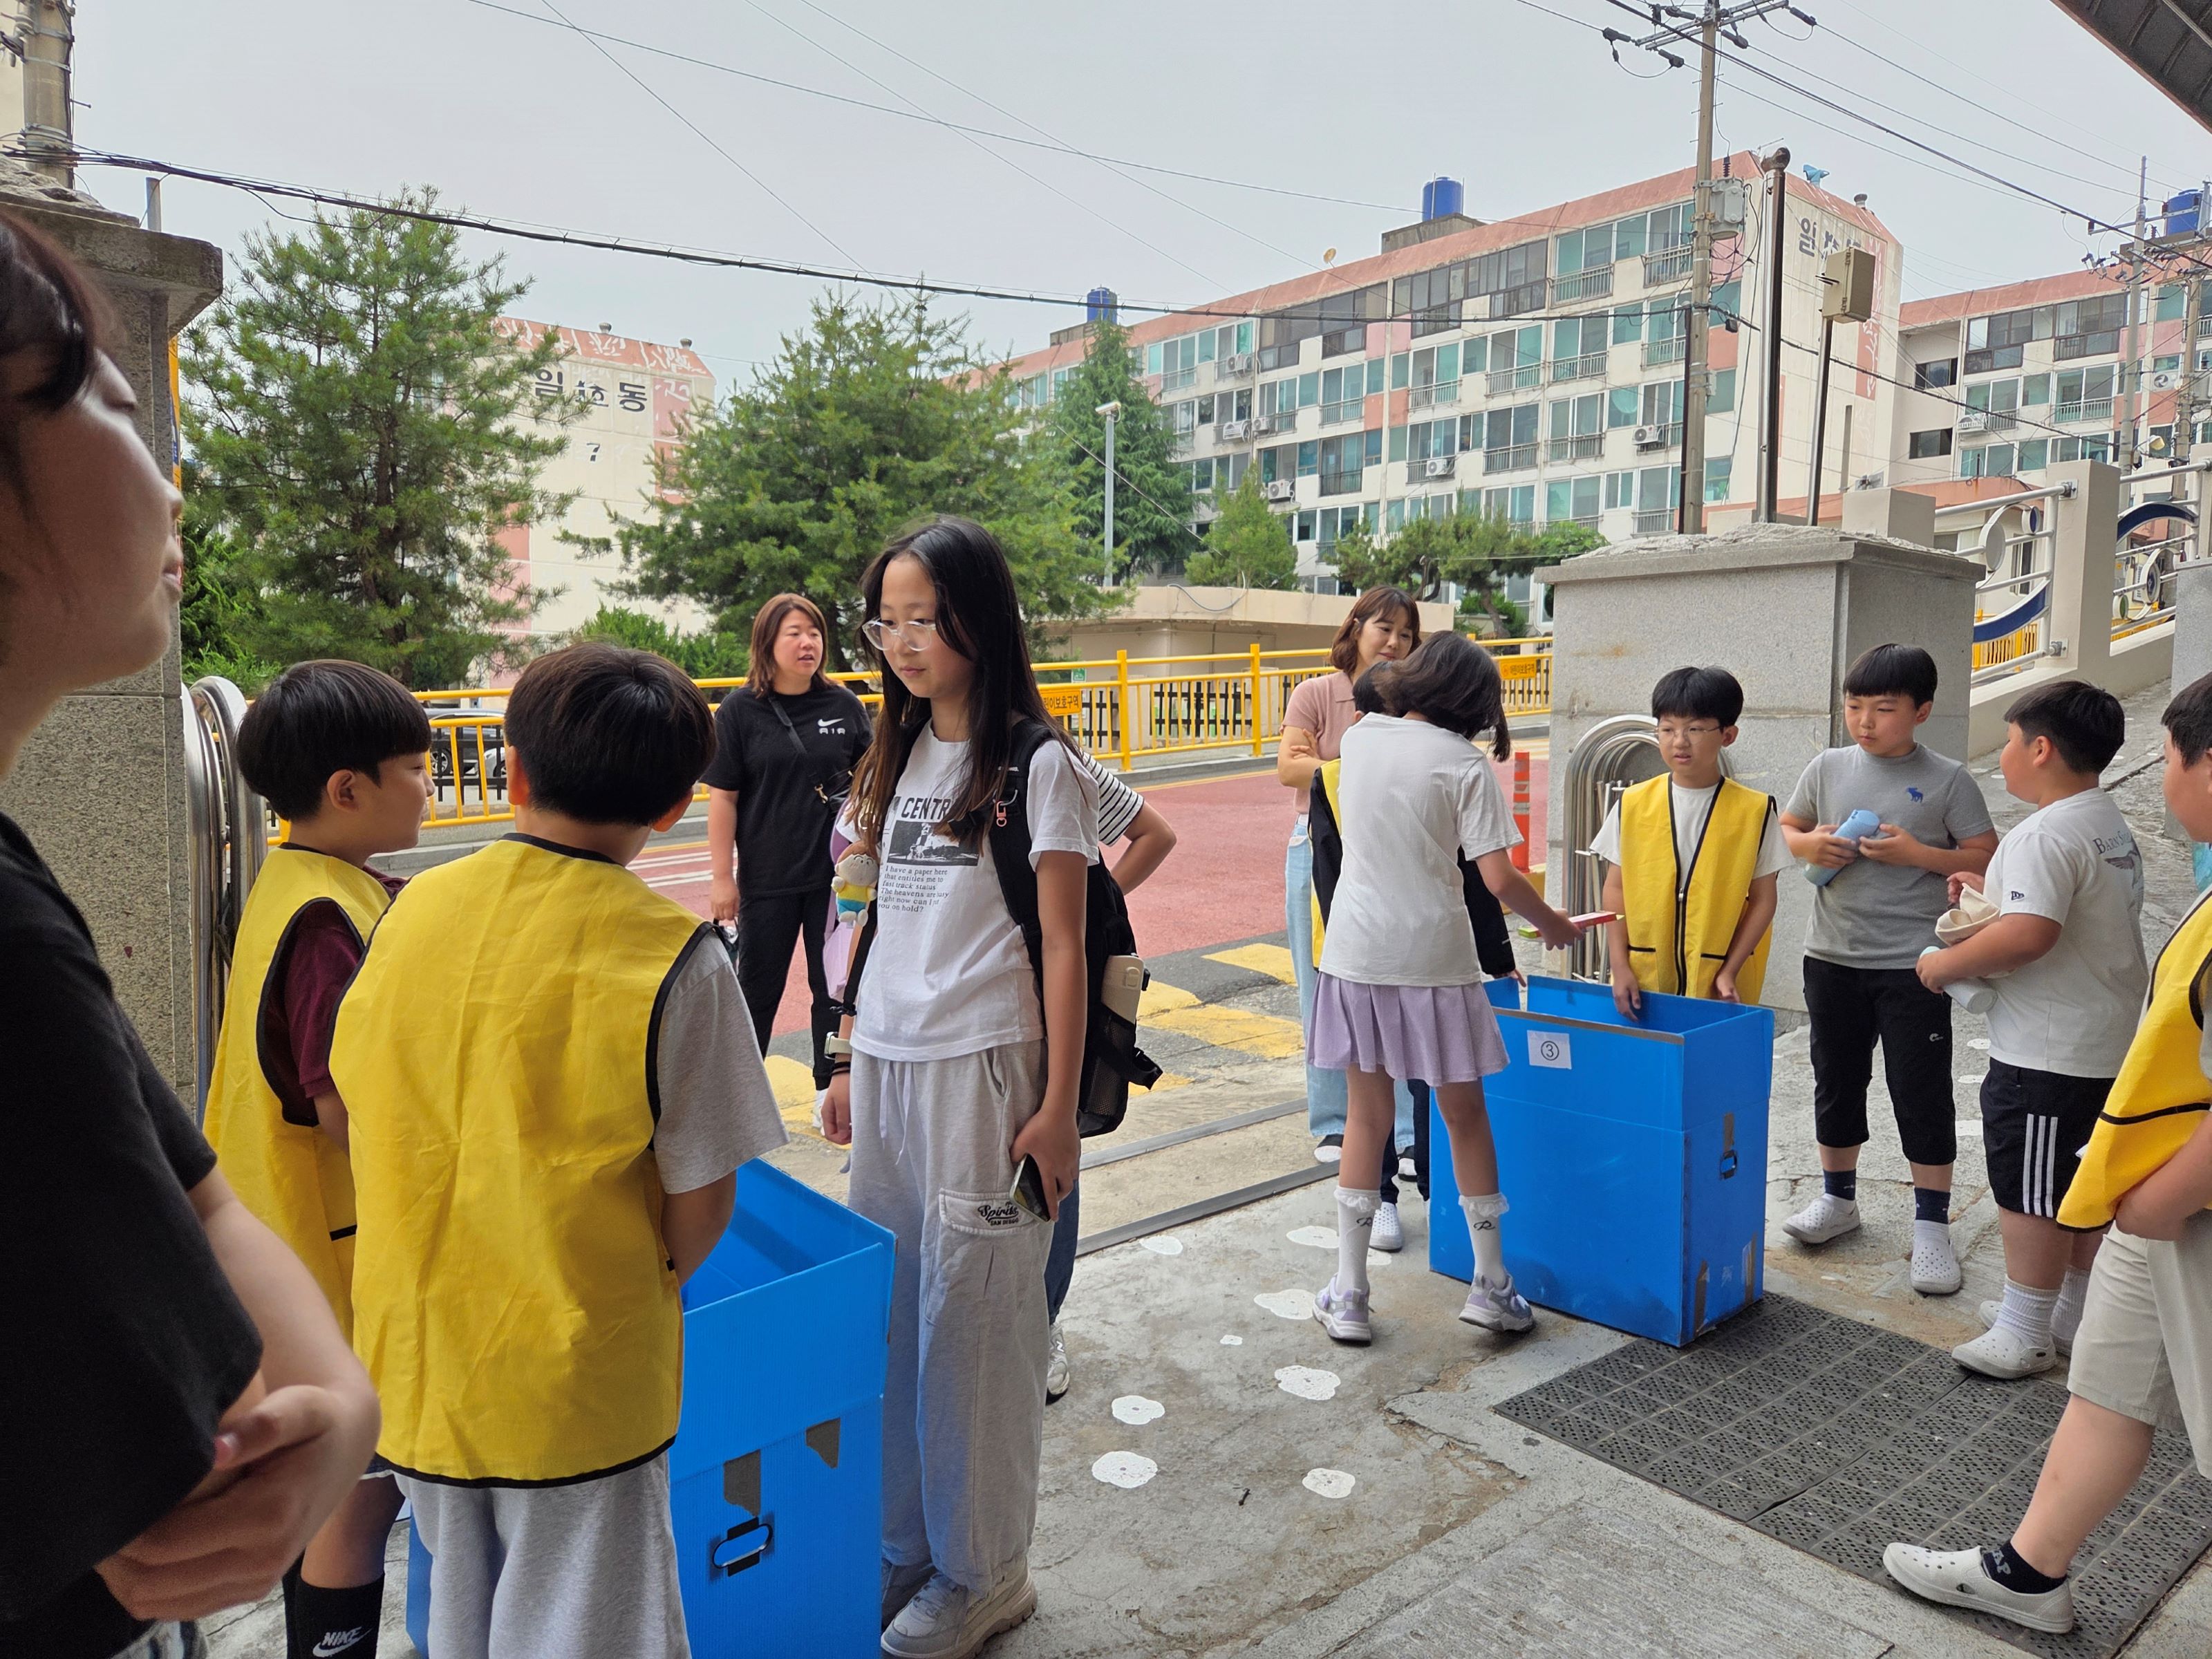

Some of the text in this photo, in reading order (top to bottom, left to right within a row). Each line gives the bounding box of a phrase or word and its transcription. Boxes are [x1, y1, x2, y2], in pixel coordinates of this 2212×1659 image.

[1043, 695, 1079, 711] 린이보호구역
[901, 797, 952, 820] CENTR
[890, 865, 906, 874] have
[894, 889, 924, 897] heavens
[977, 1203, 1020, 1222] Spirits
[321, 1626, 362, 1646] NIKE
